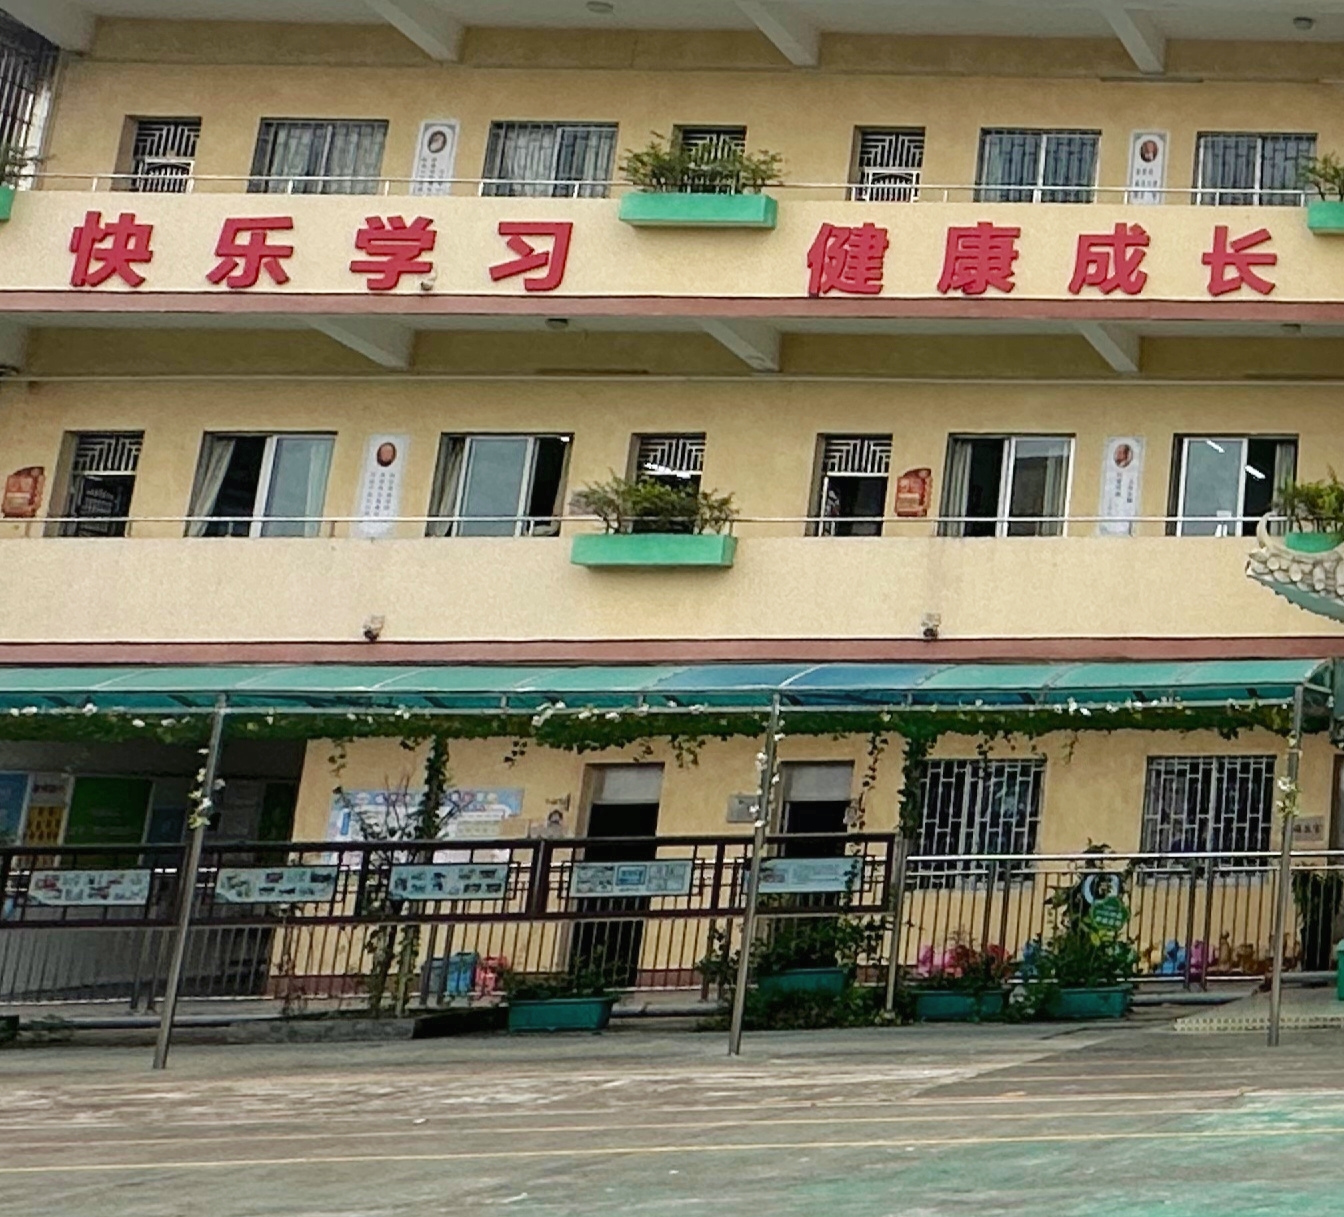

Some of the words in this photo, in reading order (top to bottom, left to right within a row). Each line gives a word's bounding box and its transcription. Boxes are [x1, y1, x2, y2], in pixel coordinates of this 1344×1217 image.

[70, 211, 573, 292] 快乐学习
[806, 221, 1277, 298] 健康成长
